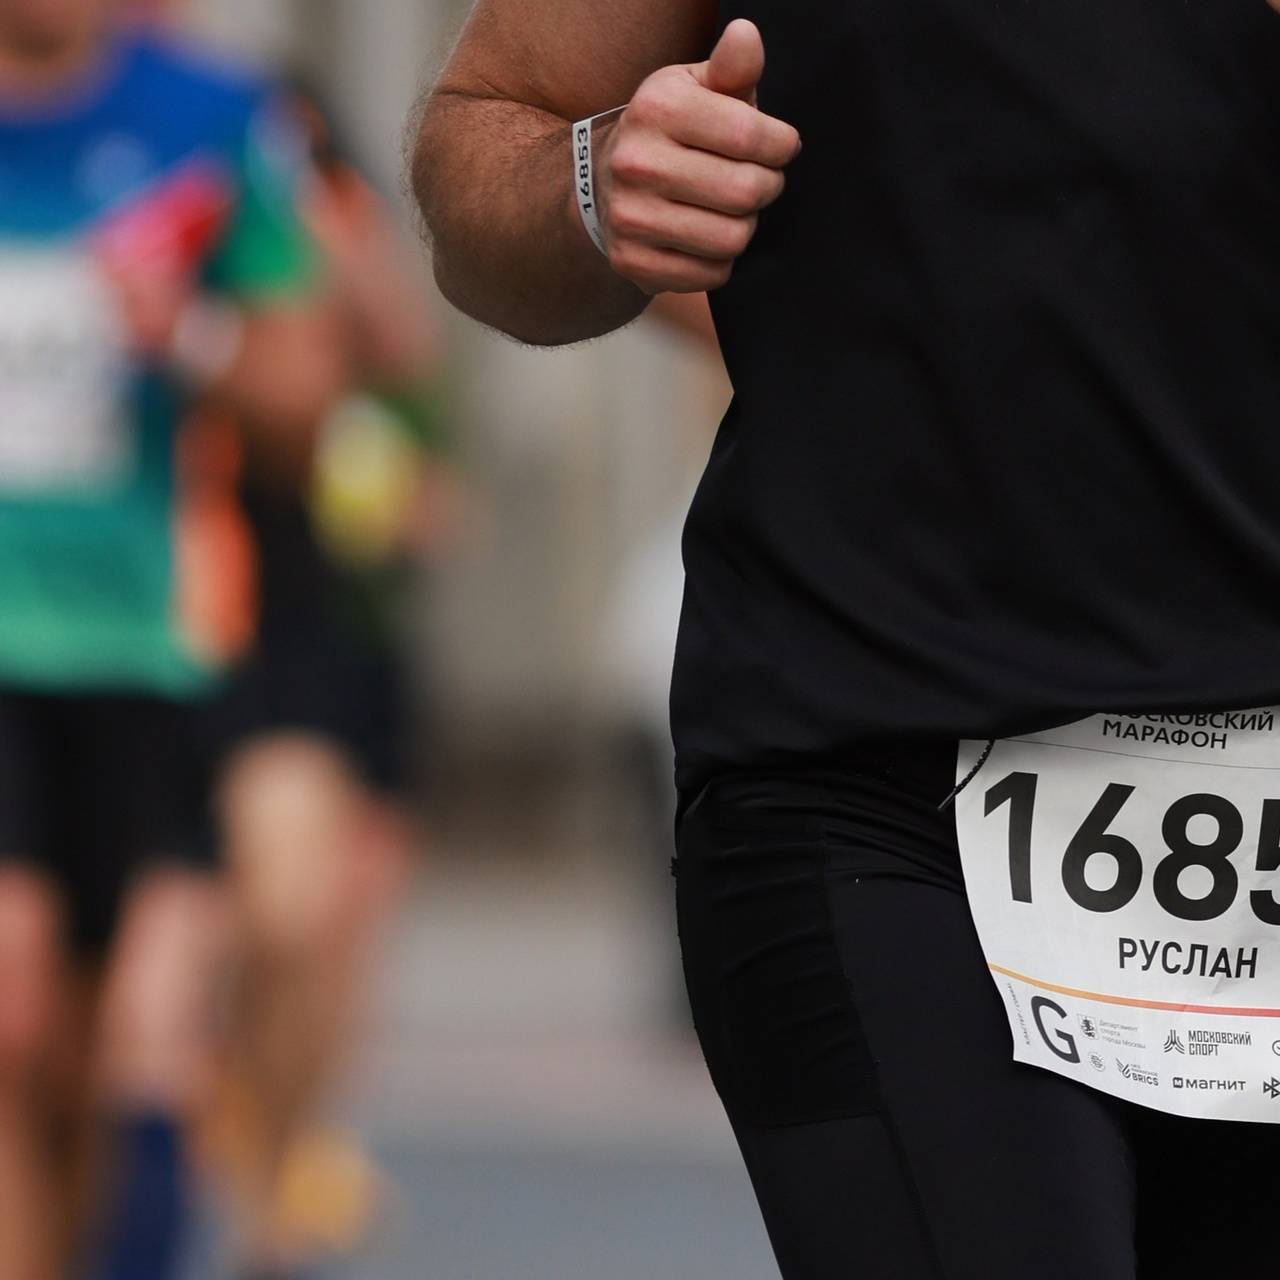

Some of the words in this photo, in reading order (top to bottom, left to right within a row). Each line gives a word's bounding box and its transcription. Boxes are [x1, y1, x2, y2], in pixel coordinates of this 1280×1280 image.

[577, 126, 593, 214] 16853
[1106, 710, 1274, 732] КОВСКИЙ
[1102, 719, 1227, 750] МАРАФОН
[1118, 937, 1259, 979] РУСЛАН
[1031, 995, 1081, 1064] G
[1188, 1030, 1252, 1046] МОСКОВСКИЙ
[1189, 1043, 1219, 1056] СПОРТ
[1132, 1072, 1159, 1086] BRICS
